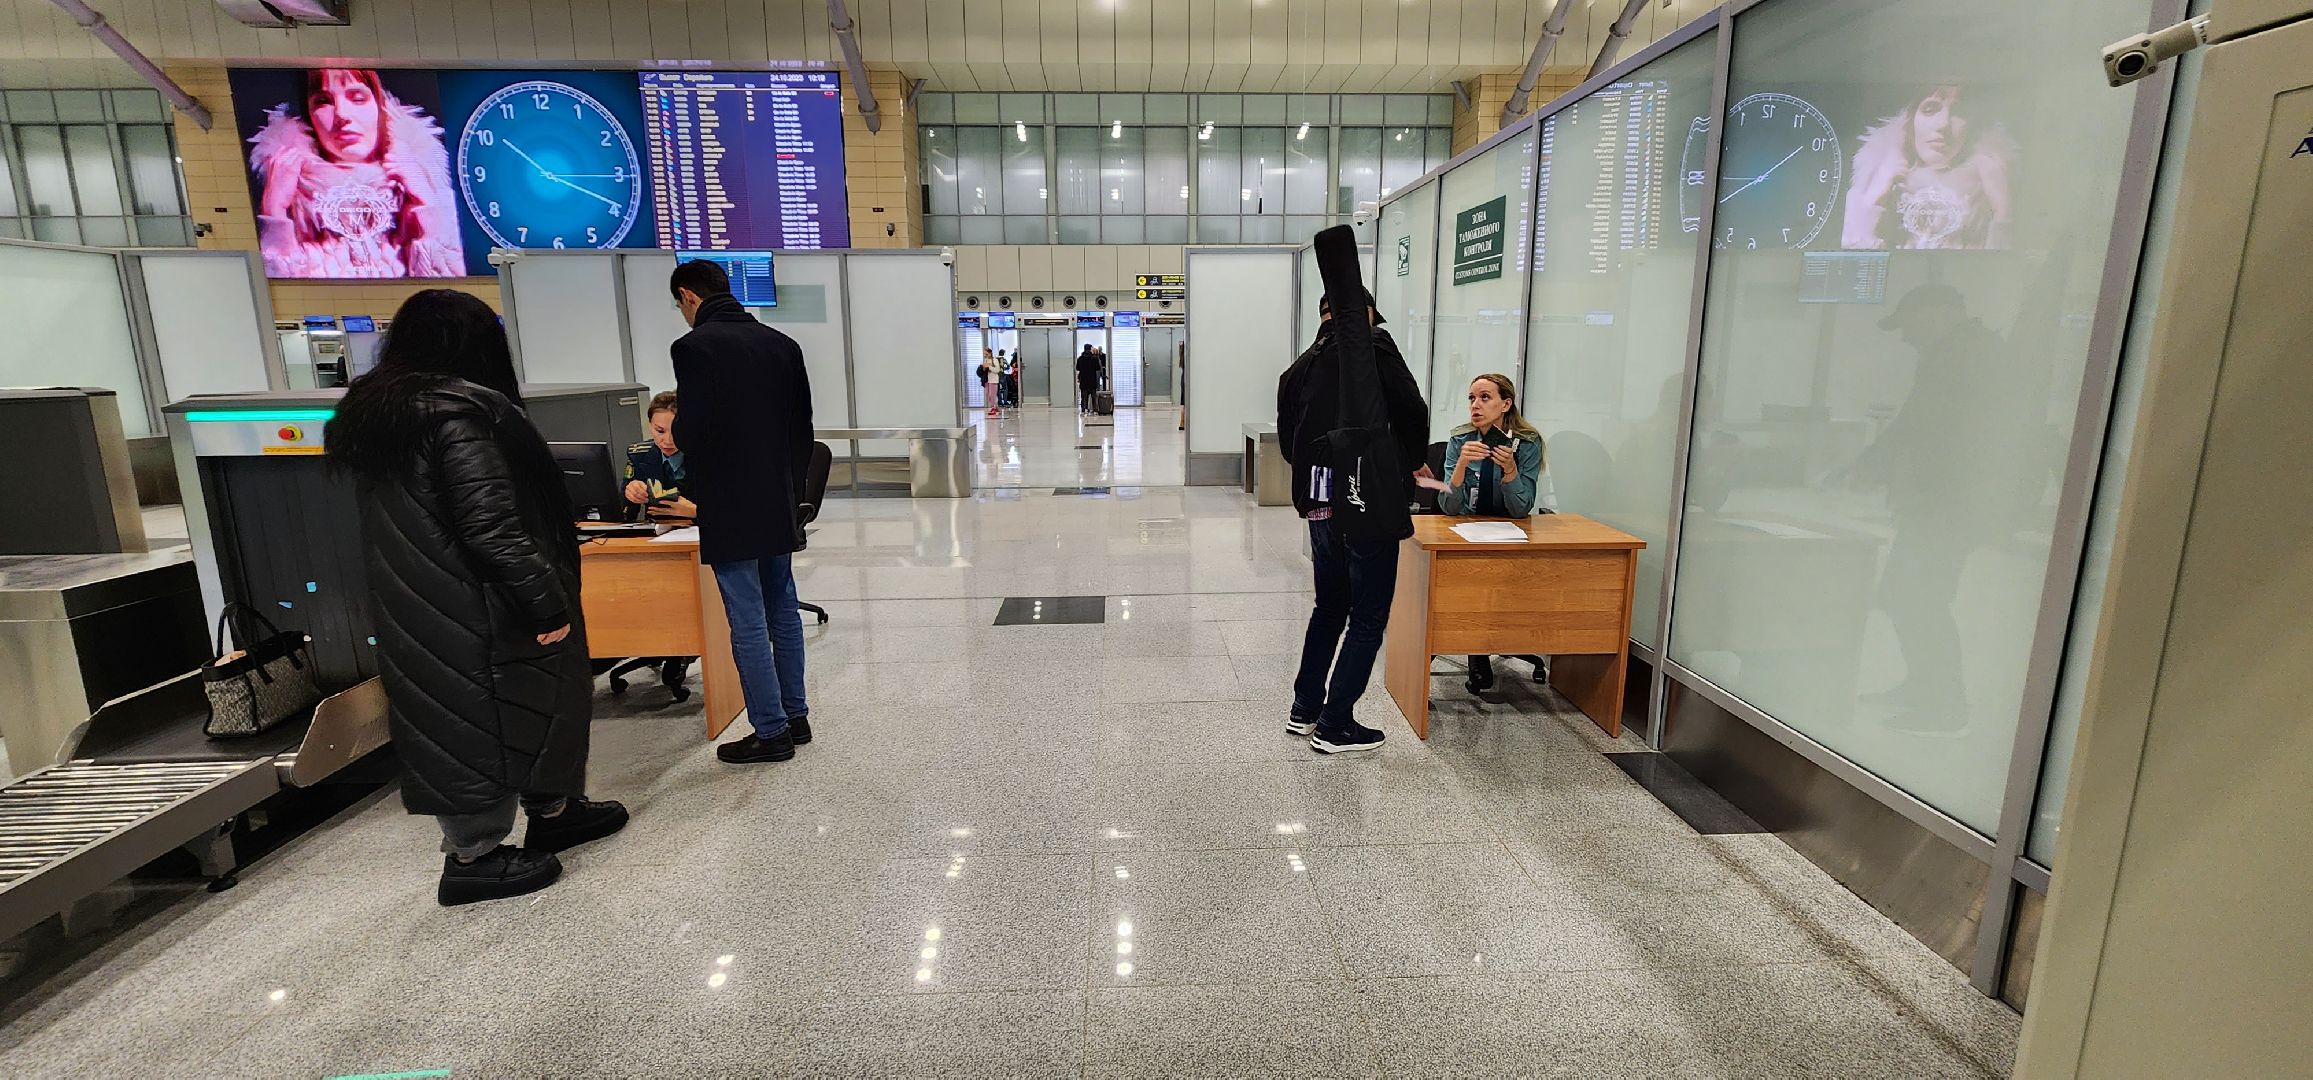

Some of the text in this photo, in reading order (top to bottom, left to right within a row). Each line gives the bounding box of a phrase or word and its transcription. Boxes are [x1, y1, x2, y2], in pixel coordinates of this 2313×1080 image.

[532, 94, 550, 110] 12
[500, 103, 514, 119] 11
[573, 103, 582, 119] 1
[476, 129, 494, 146] 10
[600, 131, 612, 147] 2
[474, 166, 486, 183] 9
[614, 166, 624, 183] 3
[489, 201, 500, 218] 8
[1471, 210, 1487, 225] ЗОНА
[517, 227, 529, 243] 7
[587, 227, 597, 244] 5
[1459, 221, 1500, 244] ТАМОЖЕННОГО
[1463, 239, 1492, 258] КОНТРОЛЯ
[1471, 265, 1488, 277] CONTROL
[1488, 262, 1500, 274] ZONE
